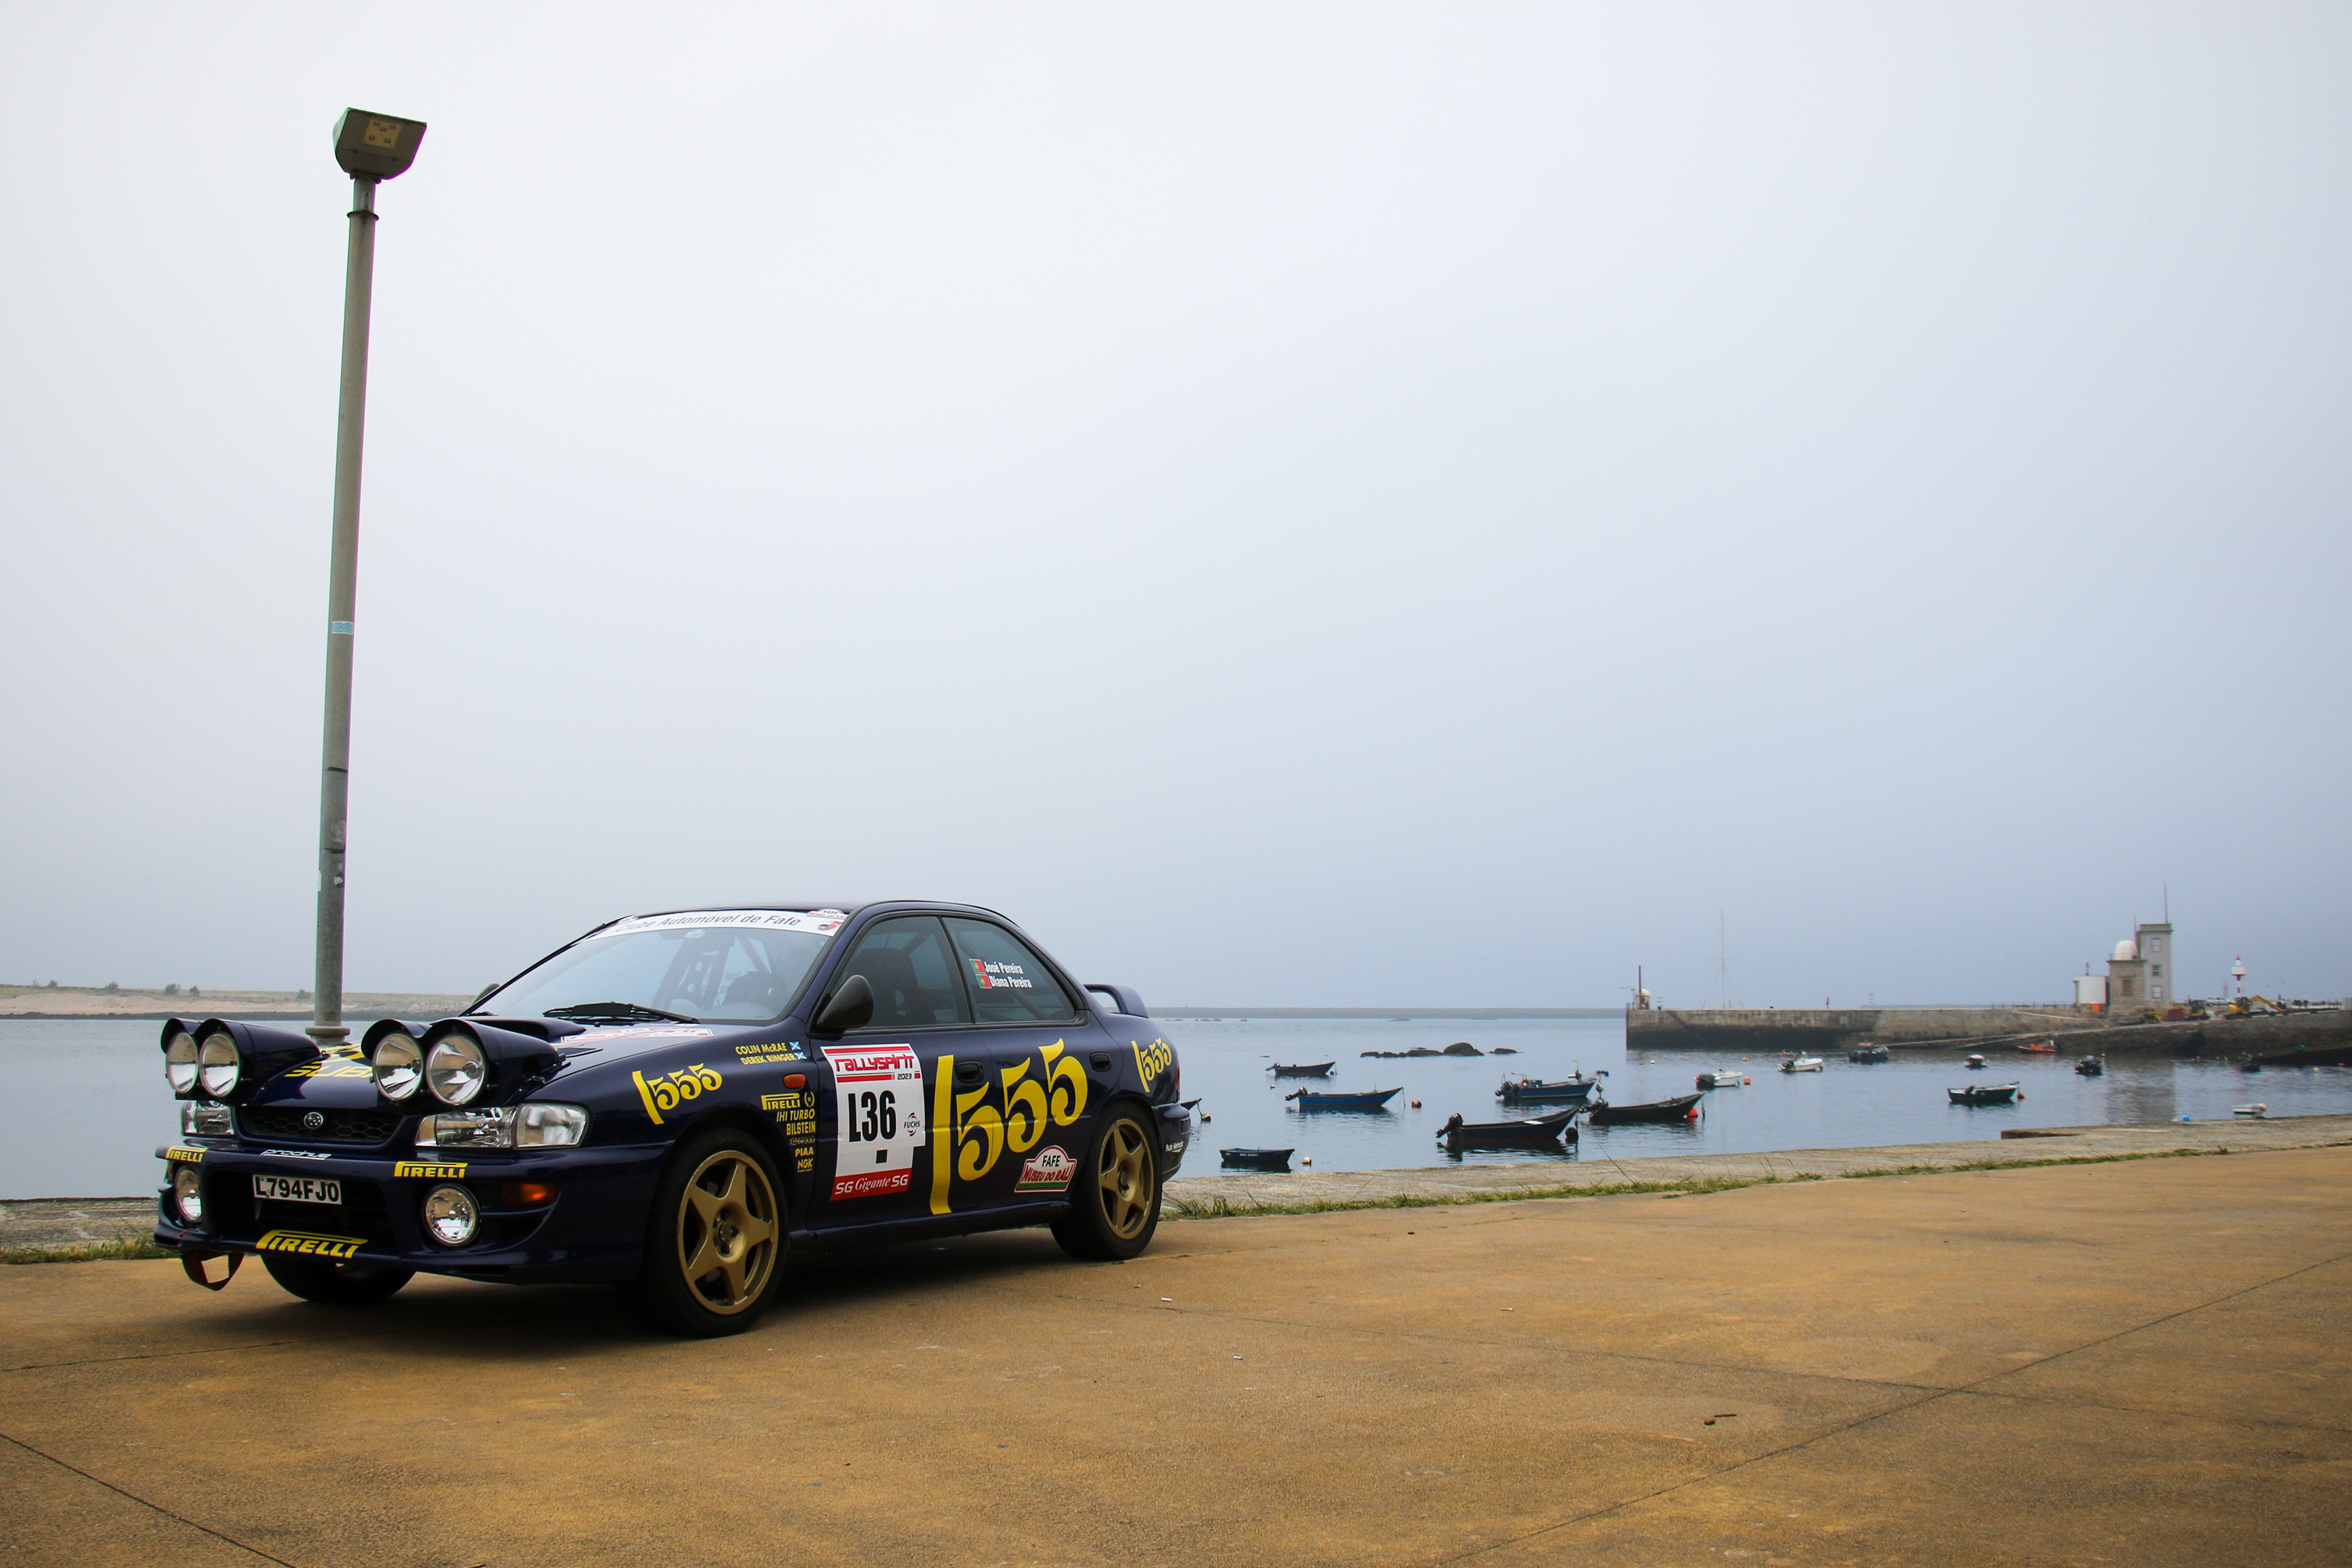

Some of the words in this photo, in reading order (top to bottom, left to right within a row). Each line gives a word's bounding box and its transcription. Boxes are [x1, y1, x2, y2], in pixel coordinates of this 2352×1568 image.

[615, 921, 656, 932] Clube
[657, 914, 740, 926] Automóvel
[741, 914, 762, 923] de
[764, 915, 801, 925] Fafe
[984, 961, 1000, 973] José
[998, 962, 1024, 974] Pereira
[988, 975, 1009, 987] Diana
[1007, 976, 1033, 988] Pereira
[735, 1045, 761, 1055] COLIN
[761, 1042, 788, 1053] McRAE
[740, 1055, 767, 1065] DEREK
[766, 1053, 797, 1063] RINGER
[284, 1066, 373, 1078] SUB
[761, 1093, 801, 1110] PIRELLI
[776, 1110, 788, 1122] IHI
[790, 1108, 815, 1121] TURBO
[848, 1090, 897, 1143] L36
[786, 1121, 816, 1136] BILSTEIN
[903, 1120, 921, 1129] FUCHS
[165, 1145, 209, 1163] PIRELLI
[795, 1147, 814, 1157] PIAA
[797, 1158, 813, 1170] NGK
[1042, 1155, 1061, 1167] FAFE
[394, 1161, 469, 1178] PIRELLI
[1021, 1164, 1046, 1182] MUSEU
[1044, 1171, 1056, 1182] DO
[1054, 1163, 1074, 1182] RALI
[834, 1181, 854, 1194] SG
[854, 1176, 891, 1192] Gigante
[891, 1174, 909, 1187] SG
[255, 1229, 368, 1259] PIRELLI
